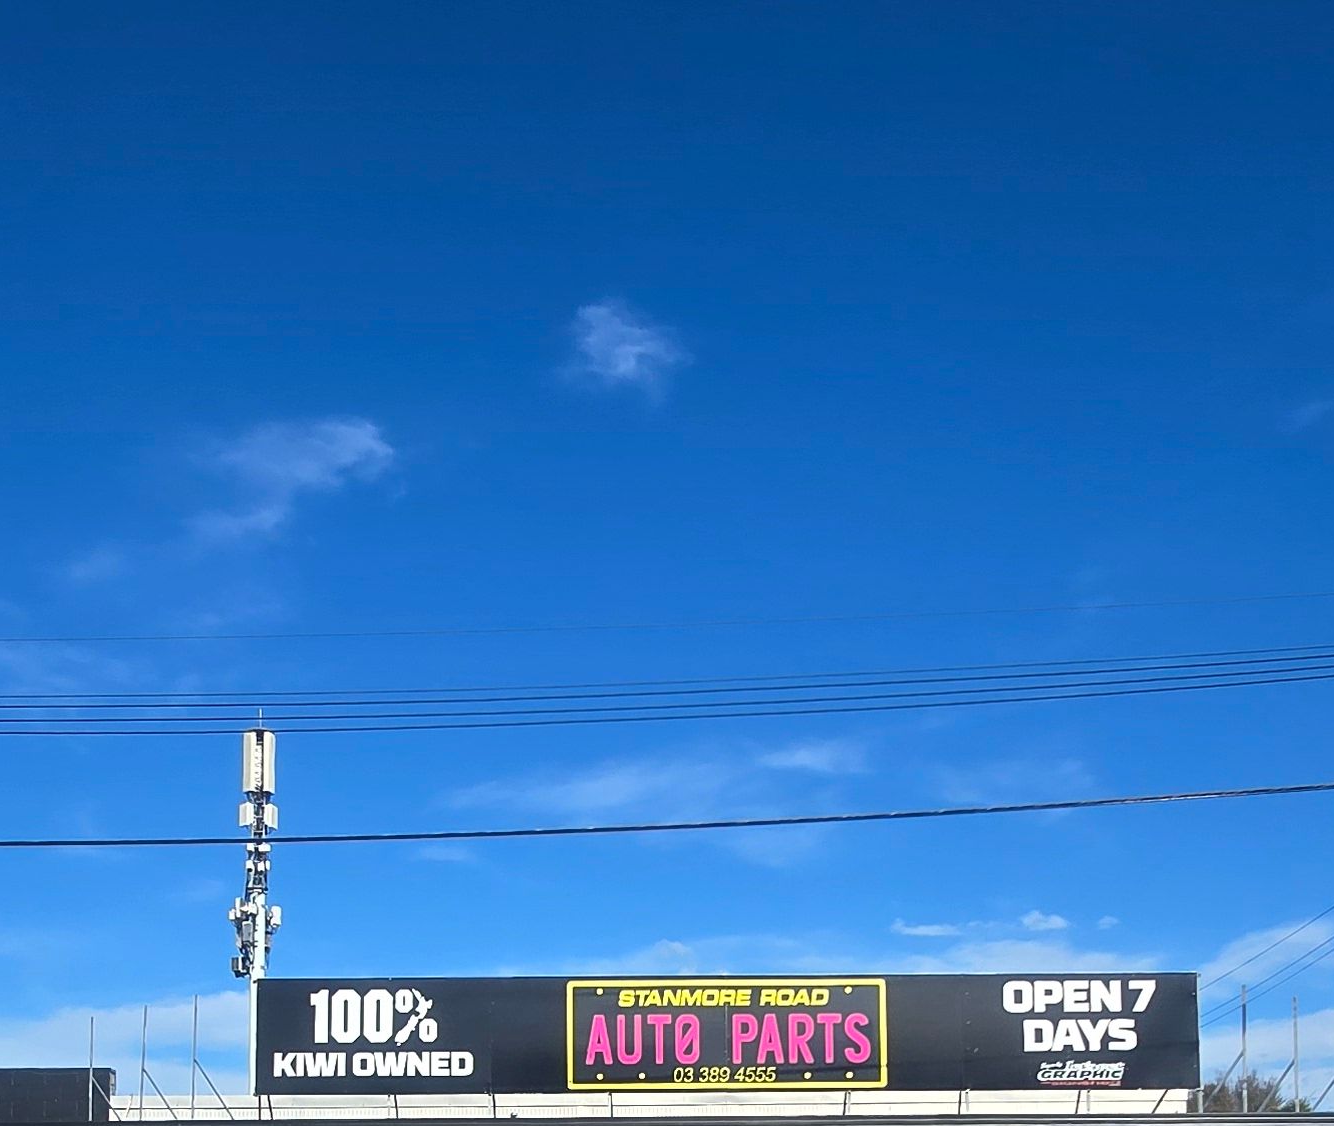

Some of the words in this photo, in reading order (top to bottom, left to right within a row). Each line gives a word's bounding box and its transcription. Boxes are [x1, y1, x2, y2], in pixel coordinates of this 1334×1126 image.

[618, 989, 752, 1007] STANMORE
[759, 988, 830, 1007] ROAD
[1002, 980, 1122, 1013] OPEN
[1128, 979, 1156, 1013] 7
[310, 988, 438, 1046] 100%
[731, 1013, 871, 1065] PARTS
[1022, 1019, 1138, 1052] DAYS
[273, 1052, 346, 1077] KIWI
[352, 1051, 474, 1077] OWNED
[673, 1067, 693, 1083] 03
[698, 1067, 730, 1083] 389
[734, 1067, 777, 1083] 4555
[1041, 1070, 1122, 1079] GRAPHIC
